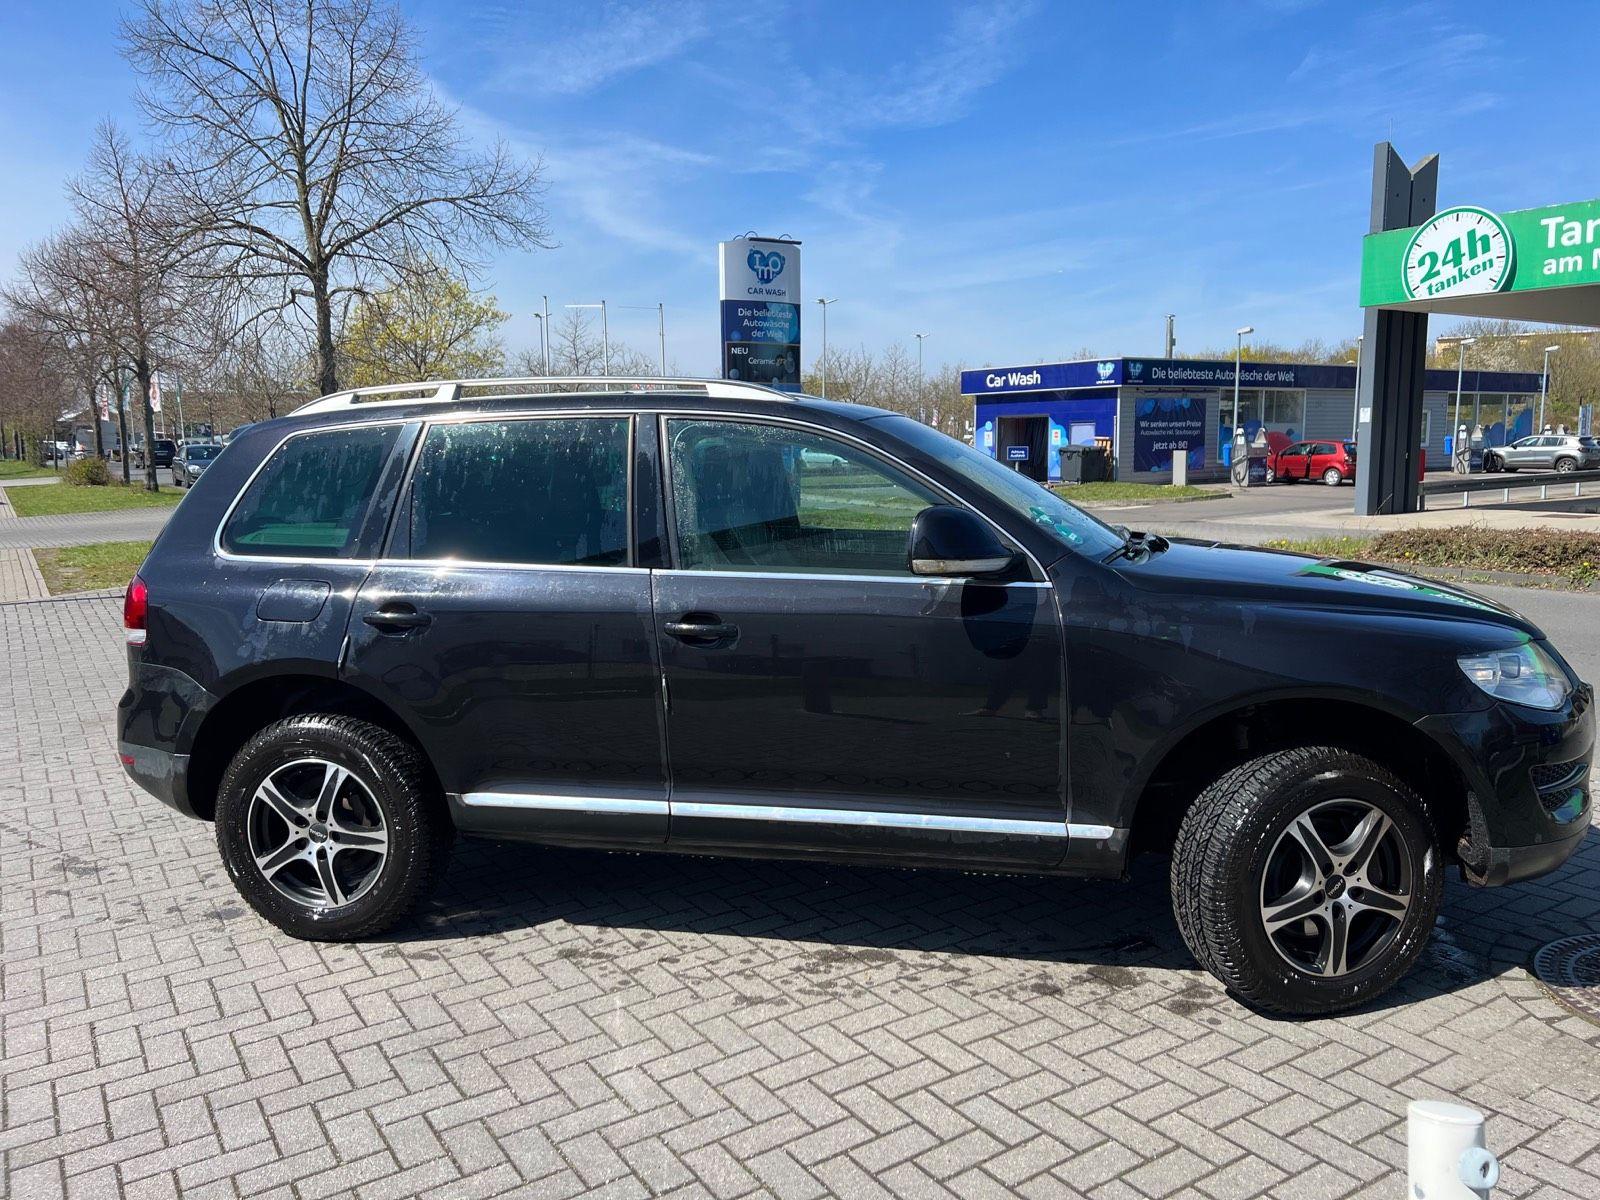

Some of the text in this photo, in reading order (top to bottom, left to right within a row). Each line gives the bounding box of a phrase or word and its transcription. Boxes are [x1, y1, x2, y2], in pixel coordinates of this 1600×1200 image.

[1417, 228, 1491, 284] 24h
[1542, 255, 1583, 275] am
[1427, 258, 1494, 296] tanken
[747, 287, 787, 297] CAR WASH
[738, 307, 793, 319] Die beliebteste
[742, 318, 790, 329] Autowäsche
[751, 329, 784, 338] der Welt
[731, 347, 749, 355] NEU
[748, 356, 776, 365] Ceramic
[986, 370, 1041, 388] Car Wash
[1152, 367, 1166, 379] Die
[1167, 367, 1214, 380] beliebteste
[1263, 370, 1277, 381] der
[1277, 370, 1295, 382] Welt
[1150, 420, 1168, 428] senken
[1187, 420, 1202, 428] Preise
[1152, 441, 1168, 452] jetzt
[1169, 440, 1177, 449] ab
